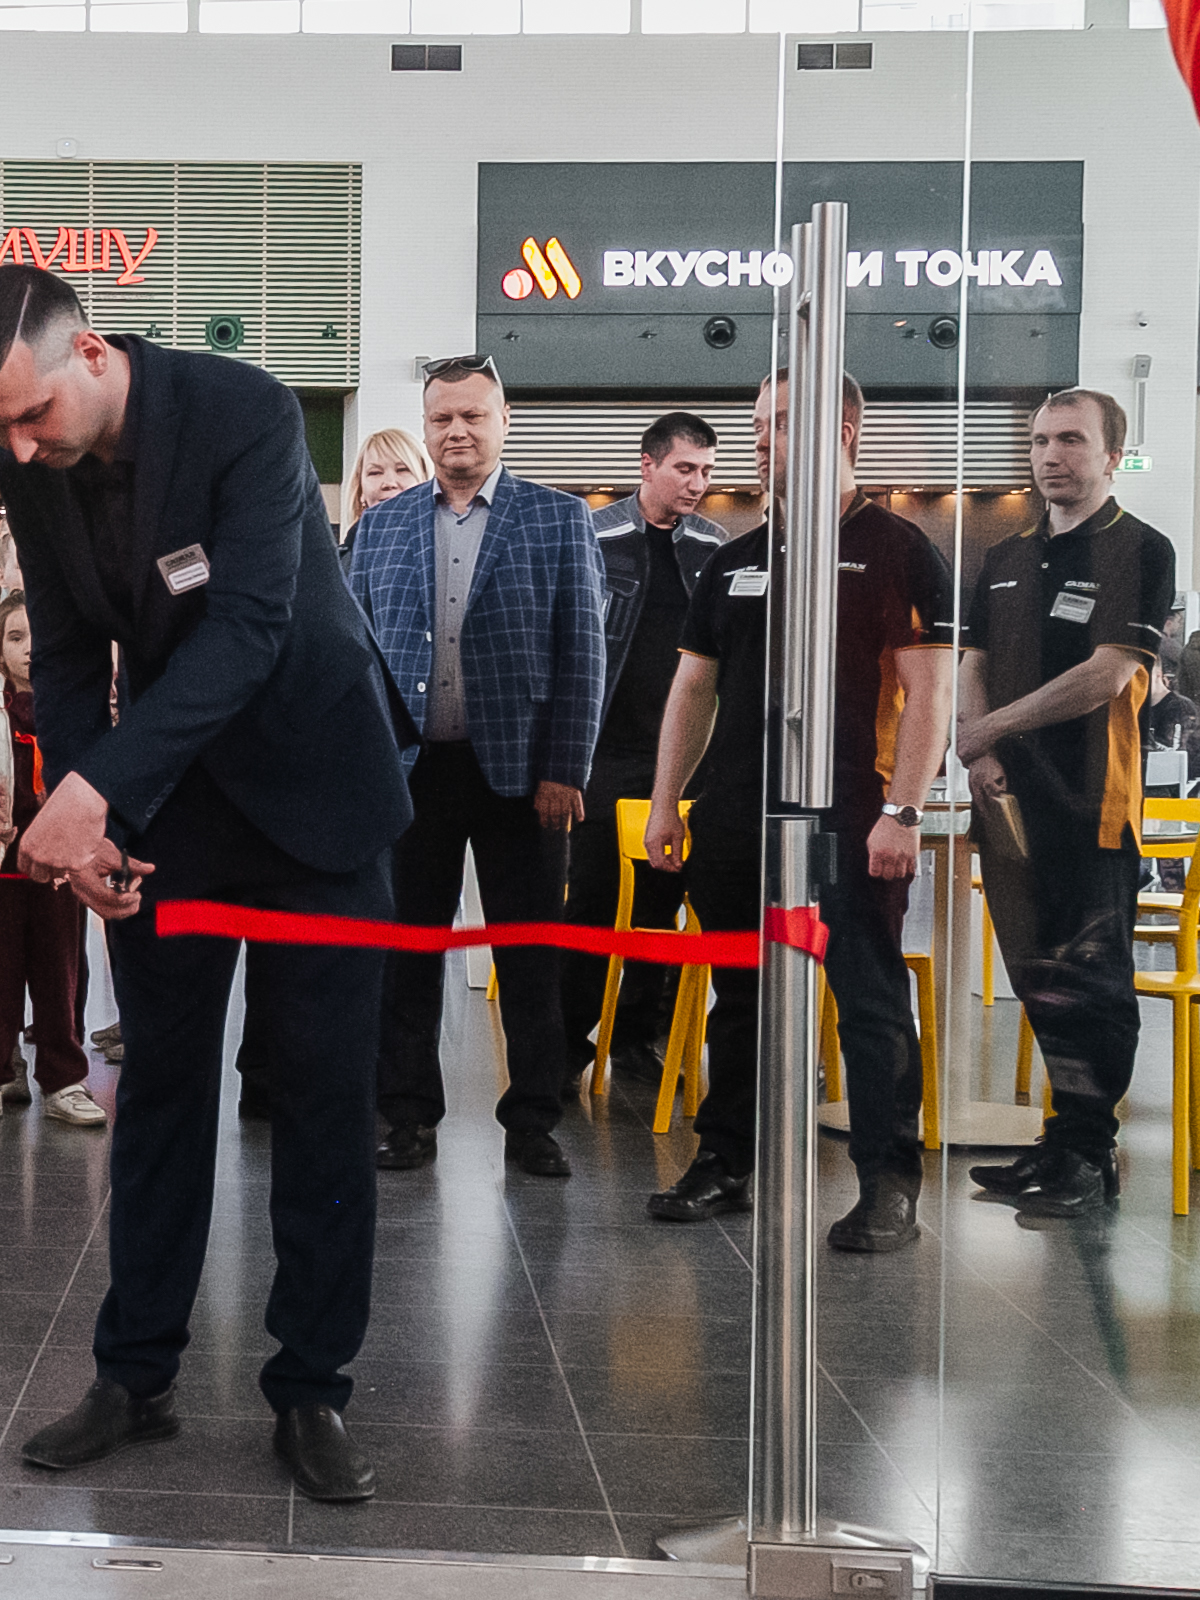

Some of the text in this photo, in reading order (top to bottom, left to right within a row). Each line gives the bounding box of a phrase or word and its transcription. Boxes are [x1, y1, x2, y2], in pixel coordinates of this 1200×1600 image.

[603, 249, 1063, 287] ВКУСНО И ТОЧКА
